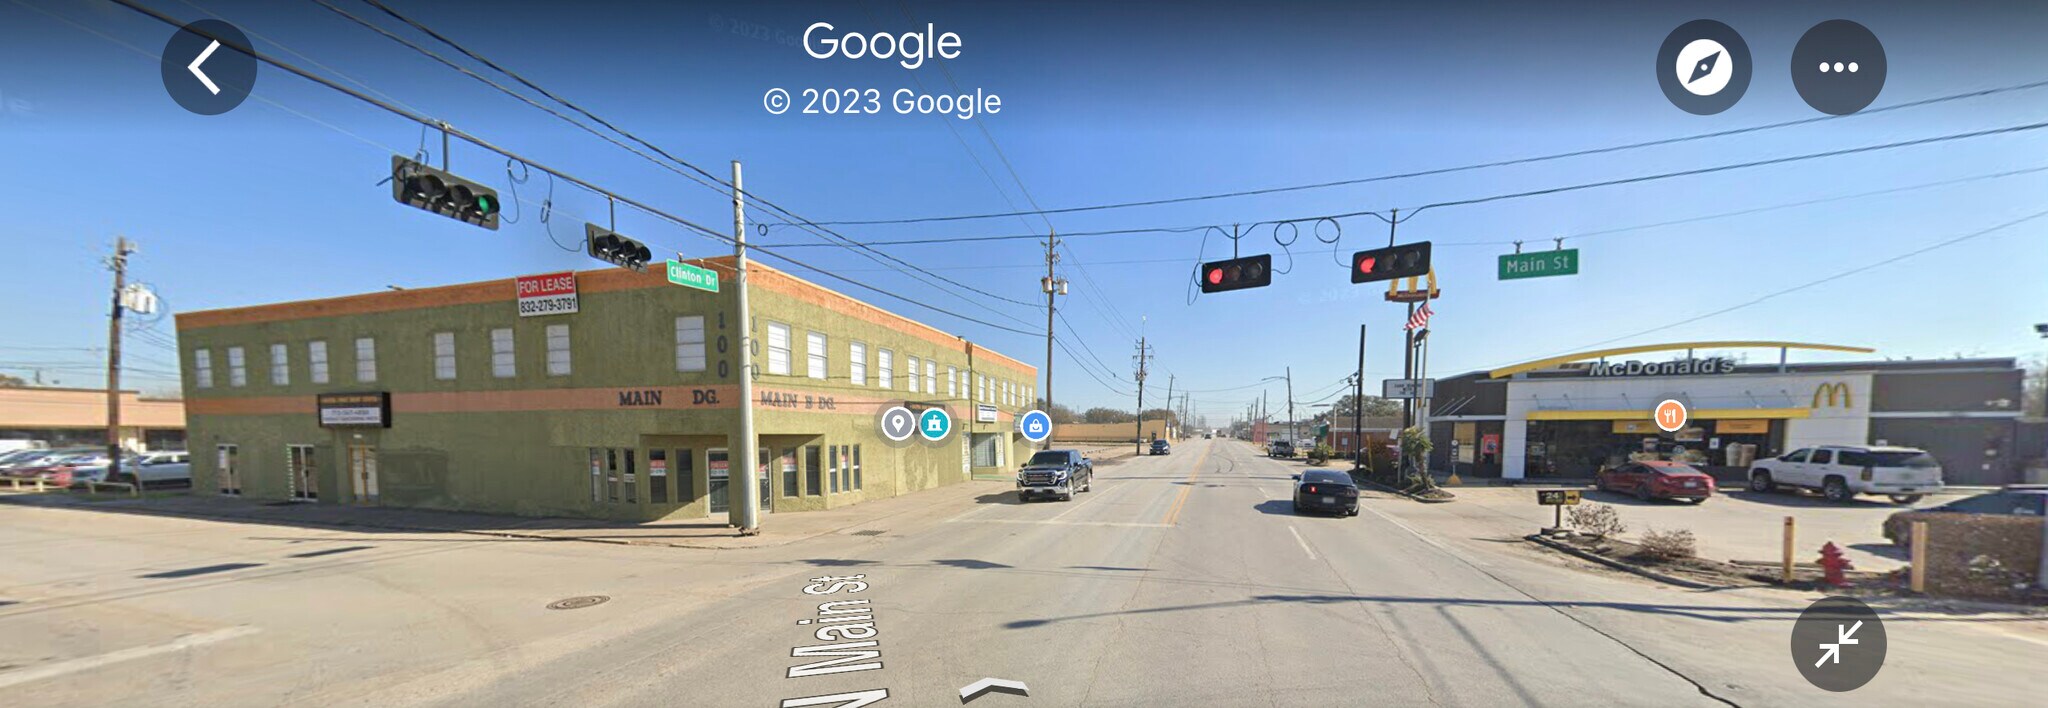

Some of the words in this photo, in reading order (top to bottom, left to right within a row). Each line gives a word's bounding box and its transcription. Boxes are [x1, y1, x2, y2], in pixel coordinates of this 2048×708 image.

[1506, 256, 1545, 273] Main
[1553, 255, 1569, 270] St
[670, 265, 702, 284] Clinton
[705, 274, 715, 286] Dr
[519, 279, 540, 294] FOR
[541, 276, 573, 292] LEASE
[520, 297, 577, 313] 832-279-3791
[1589, 358, 1736, 377] McDonald's
[618, 390, 662, 406] MAIN
[692, 389, 720, 405] DG.
[760, 390, 798, 409] MAIN
